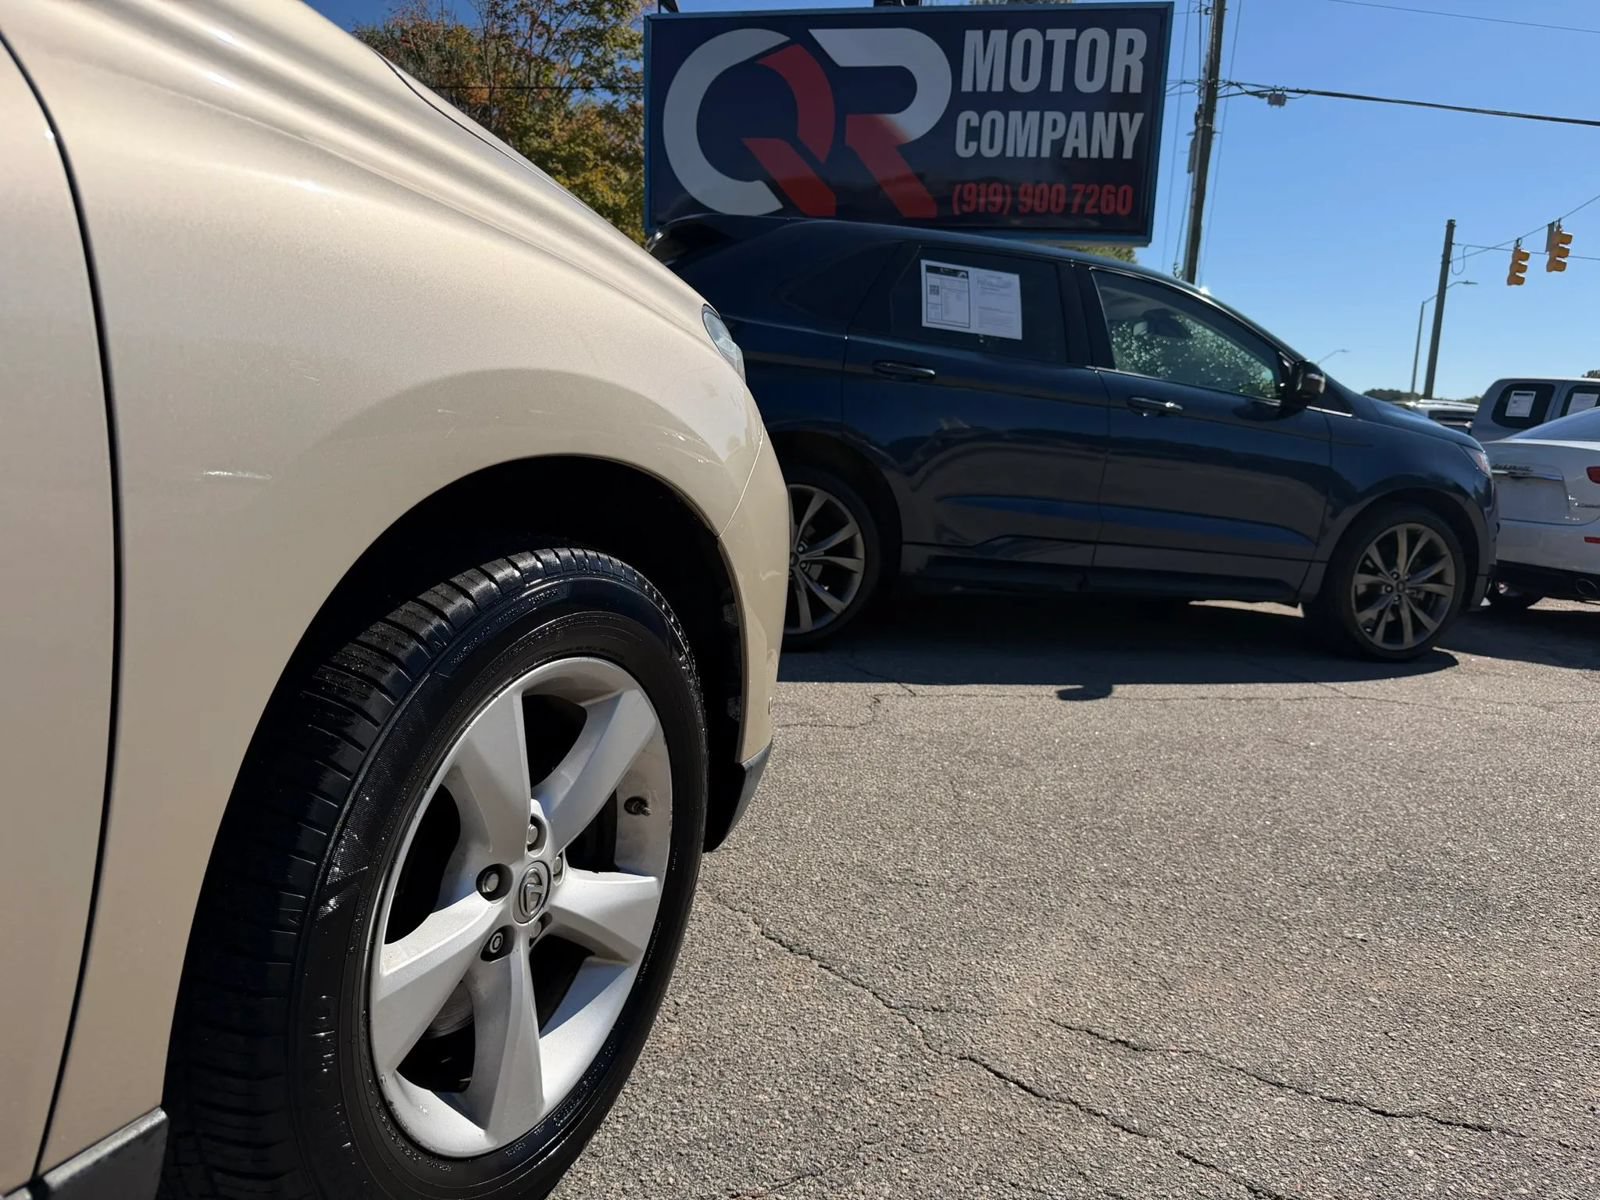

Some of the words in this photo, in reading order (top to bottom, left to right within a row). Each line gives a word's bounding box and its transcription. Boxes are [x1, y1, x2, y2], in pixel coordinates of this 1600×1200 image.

[961, 27, 1147, 93] MOTOR
[663, 28, 952, 218] QR
[955, 110, 1144, 159] COMPANY
[952, 183, 1012, 215] (919)
[1018, 183, 1066, 215] 900
[1071, 184, 1134, 216] 7260
